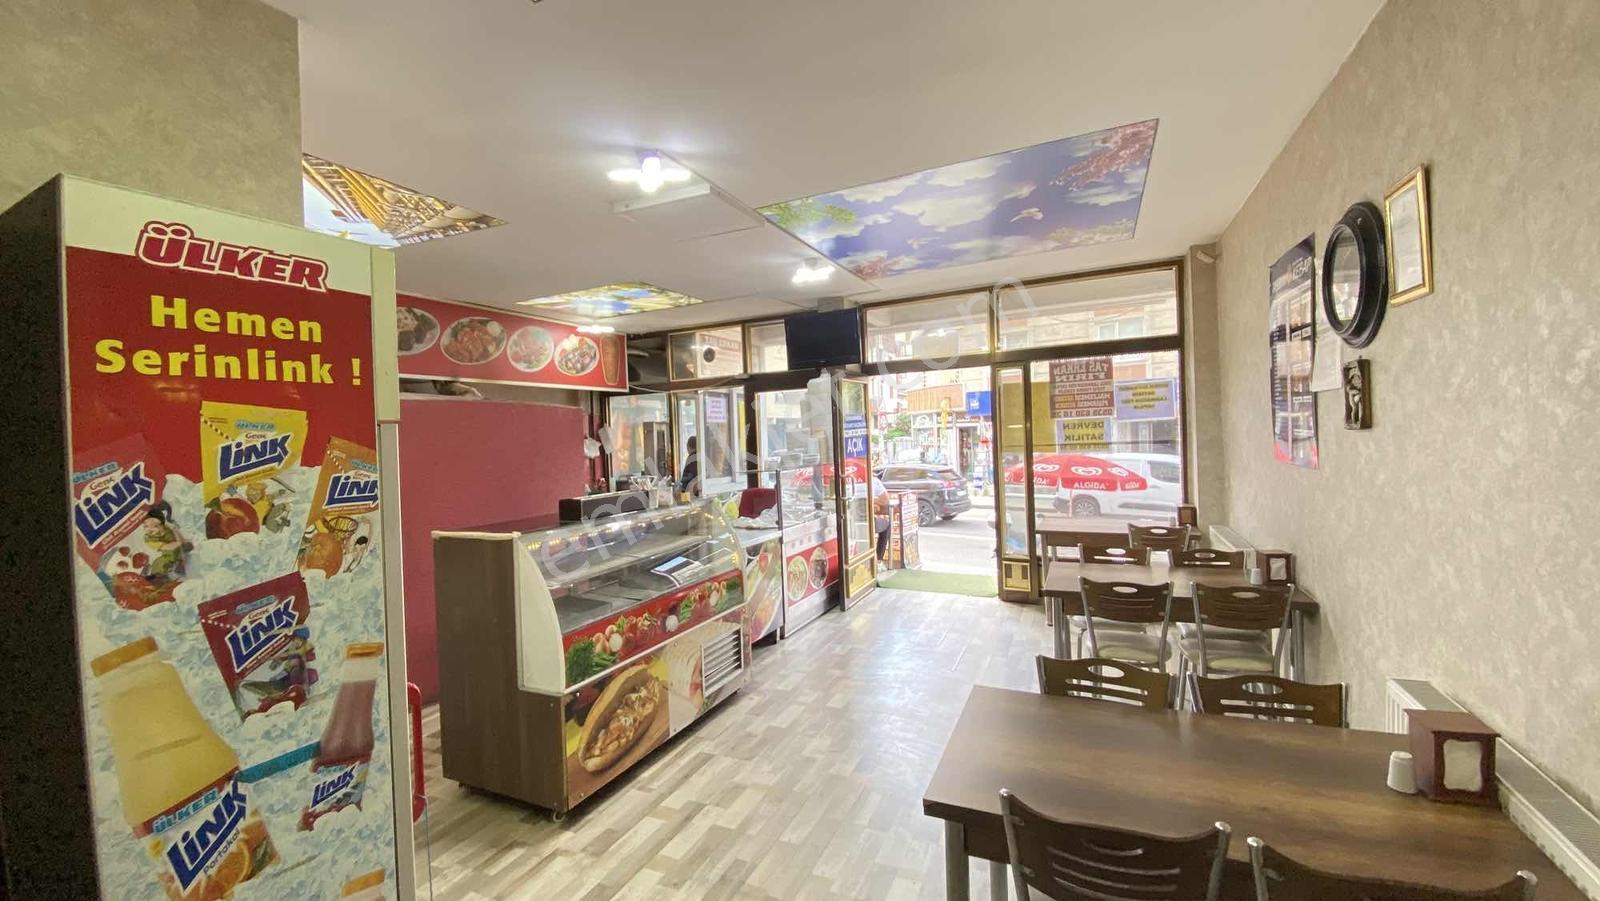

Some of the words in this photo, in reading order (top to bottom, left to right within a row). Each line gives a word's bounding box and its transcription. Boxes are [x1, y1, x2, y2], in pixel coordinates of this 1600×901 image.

[136, 221, 328, 291] ÜLKER
[150, 295, 322, 343] Hemen
[95, 338, 335, 384] Serinlink
[351, 358, 361, 385] !
[847, 438, 864, 458] AÇIK
[153, 789, 219, 834] ÜLKER
[203, 828, 241, 875] Portakal
